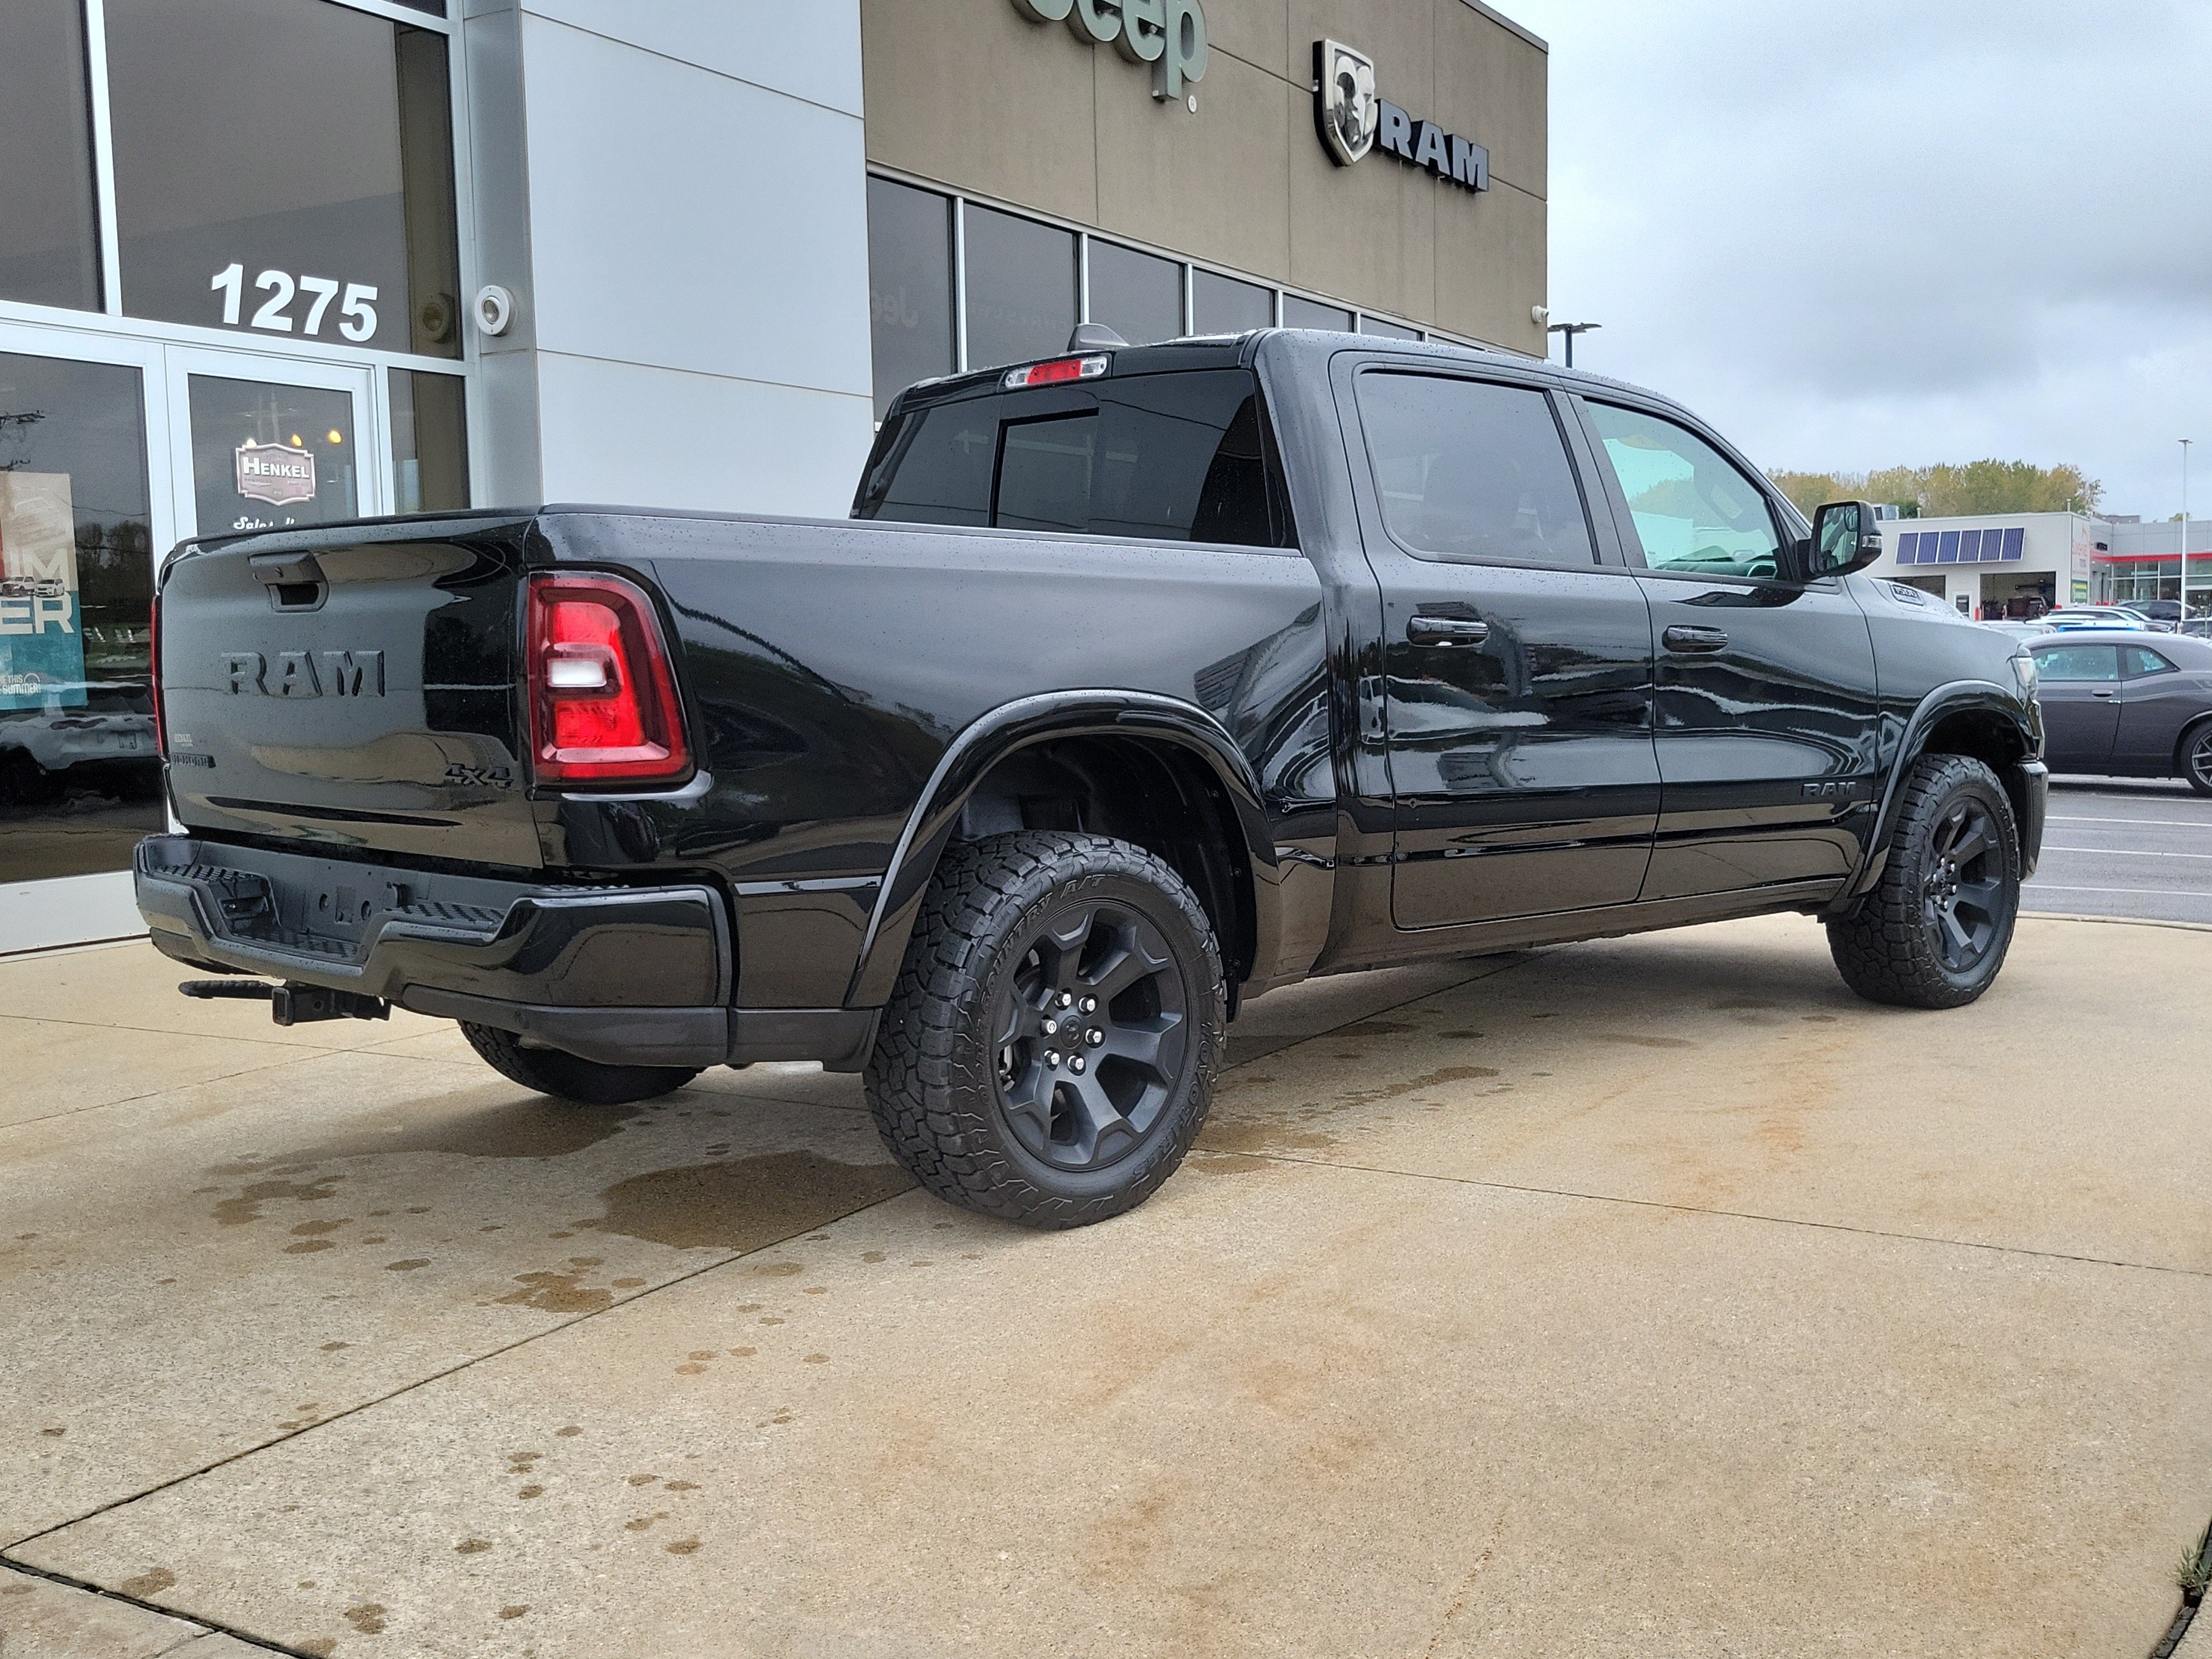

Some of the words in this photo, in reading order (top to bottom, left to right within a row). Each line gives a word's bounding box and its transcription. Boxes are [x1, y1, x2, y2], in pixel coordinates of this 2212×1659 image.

[1025, 0, 1208, 100] eep
[1379, 98, 1489, 191] RAM
[212, 263, 378, 342] 1275
[242, 456, 310, 478] HENKEL
[8, 674, 23, 684] THIS
[221, 651, 385, 697] RAM
[1801, 782, 1857, 797] RAM
